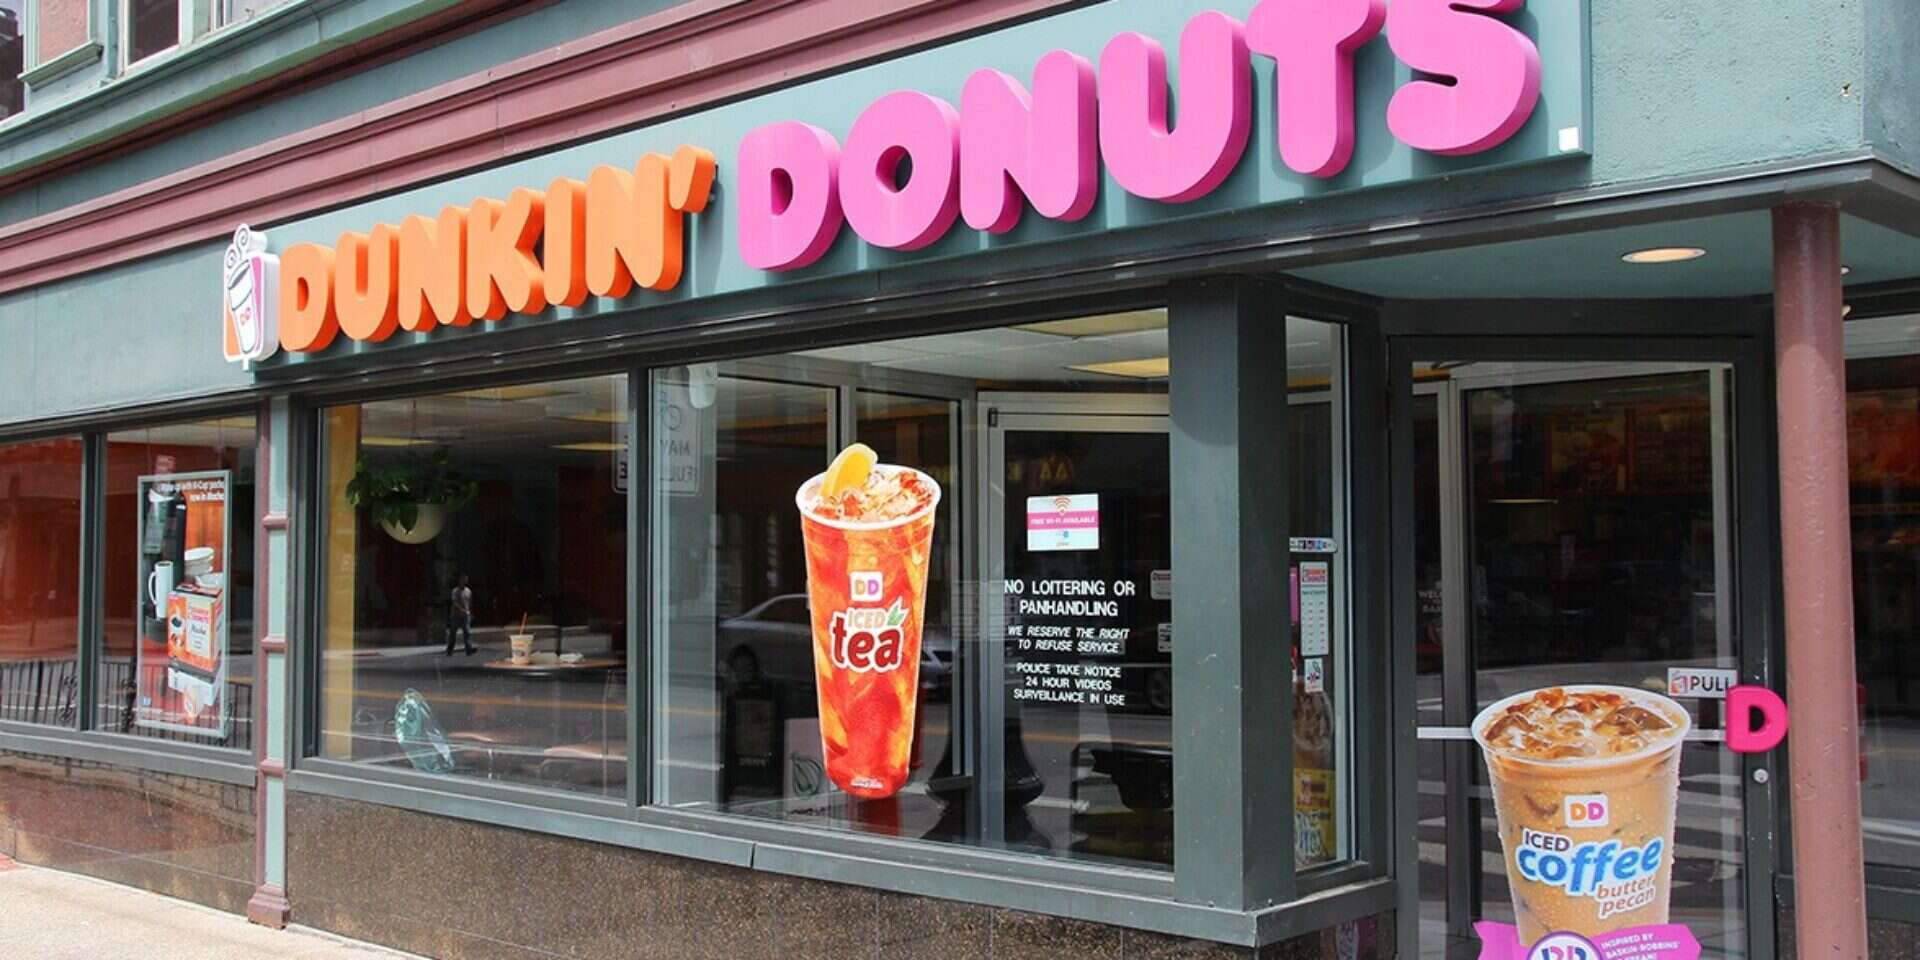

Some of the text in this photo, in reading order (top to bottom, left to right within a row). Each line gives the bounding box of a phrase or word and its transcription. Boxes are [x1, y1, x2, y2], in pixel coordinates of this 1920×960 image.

[279, 0, 1541, 352] DUNKIN' DONUTS
[855, 580, 879, 595] DD
[1004, 579, 1024, 594] NO
[1032, 580, 1105, 596] LOITERING
[1114, 581, 1136, 596] OR
[1019, 600, 1118, 617] PANHANDLING
[849, 611, 886, 629] ICED
[833, 616, 901, 668] tea
[1008, 626, 1130, 640] WE RESERVE THE RIGHT
[1018, 640, 1120, 653] TO REFUSE SERVICE
[1016, 663, 1121, 678] POLICE TAKE NOTICE
[1025, 676, 1112, 691] 24 HOUR VIDEOS
[1013, 688, 1125, 706] SURVEILLANCE IN USE
[1570, 802, 1604, 821] DD
[1525, 831, 1570, 852] ICED
[1518, 839, 1662, 892] coffee
[1598, 877, 1656, 898] butter
[1602, 889, 1654, 917] pecan
[1601, 933, 1654, 949] INSPIRED BY
